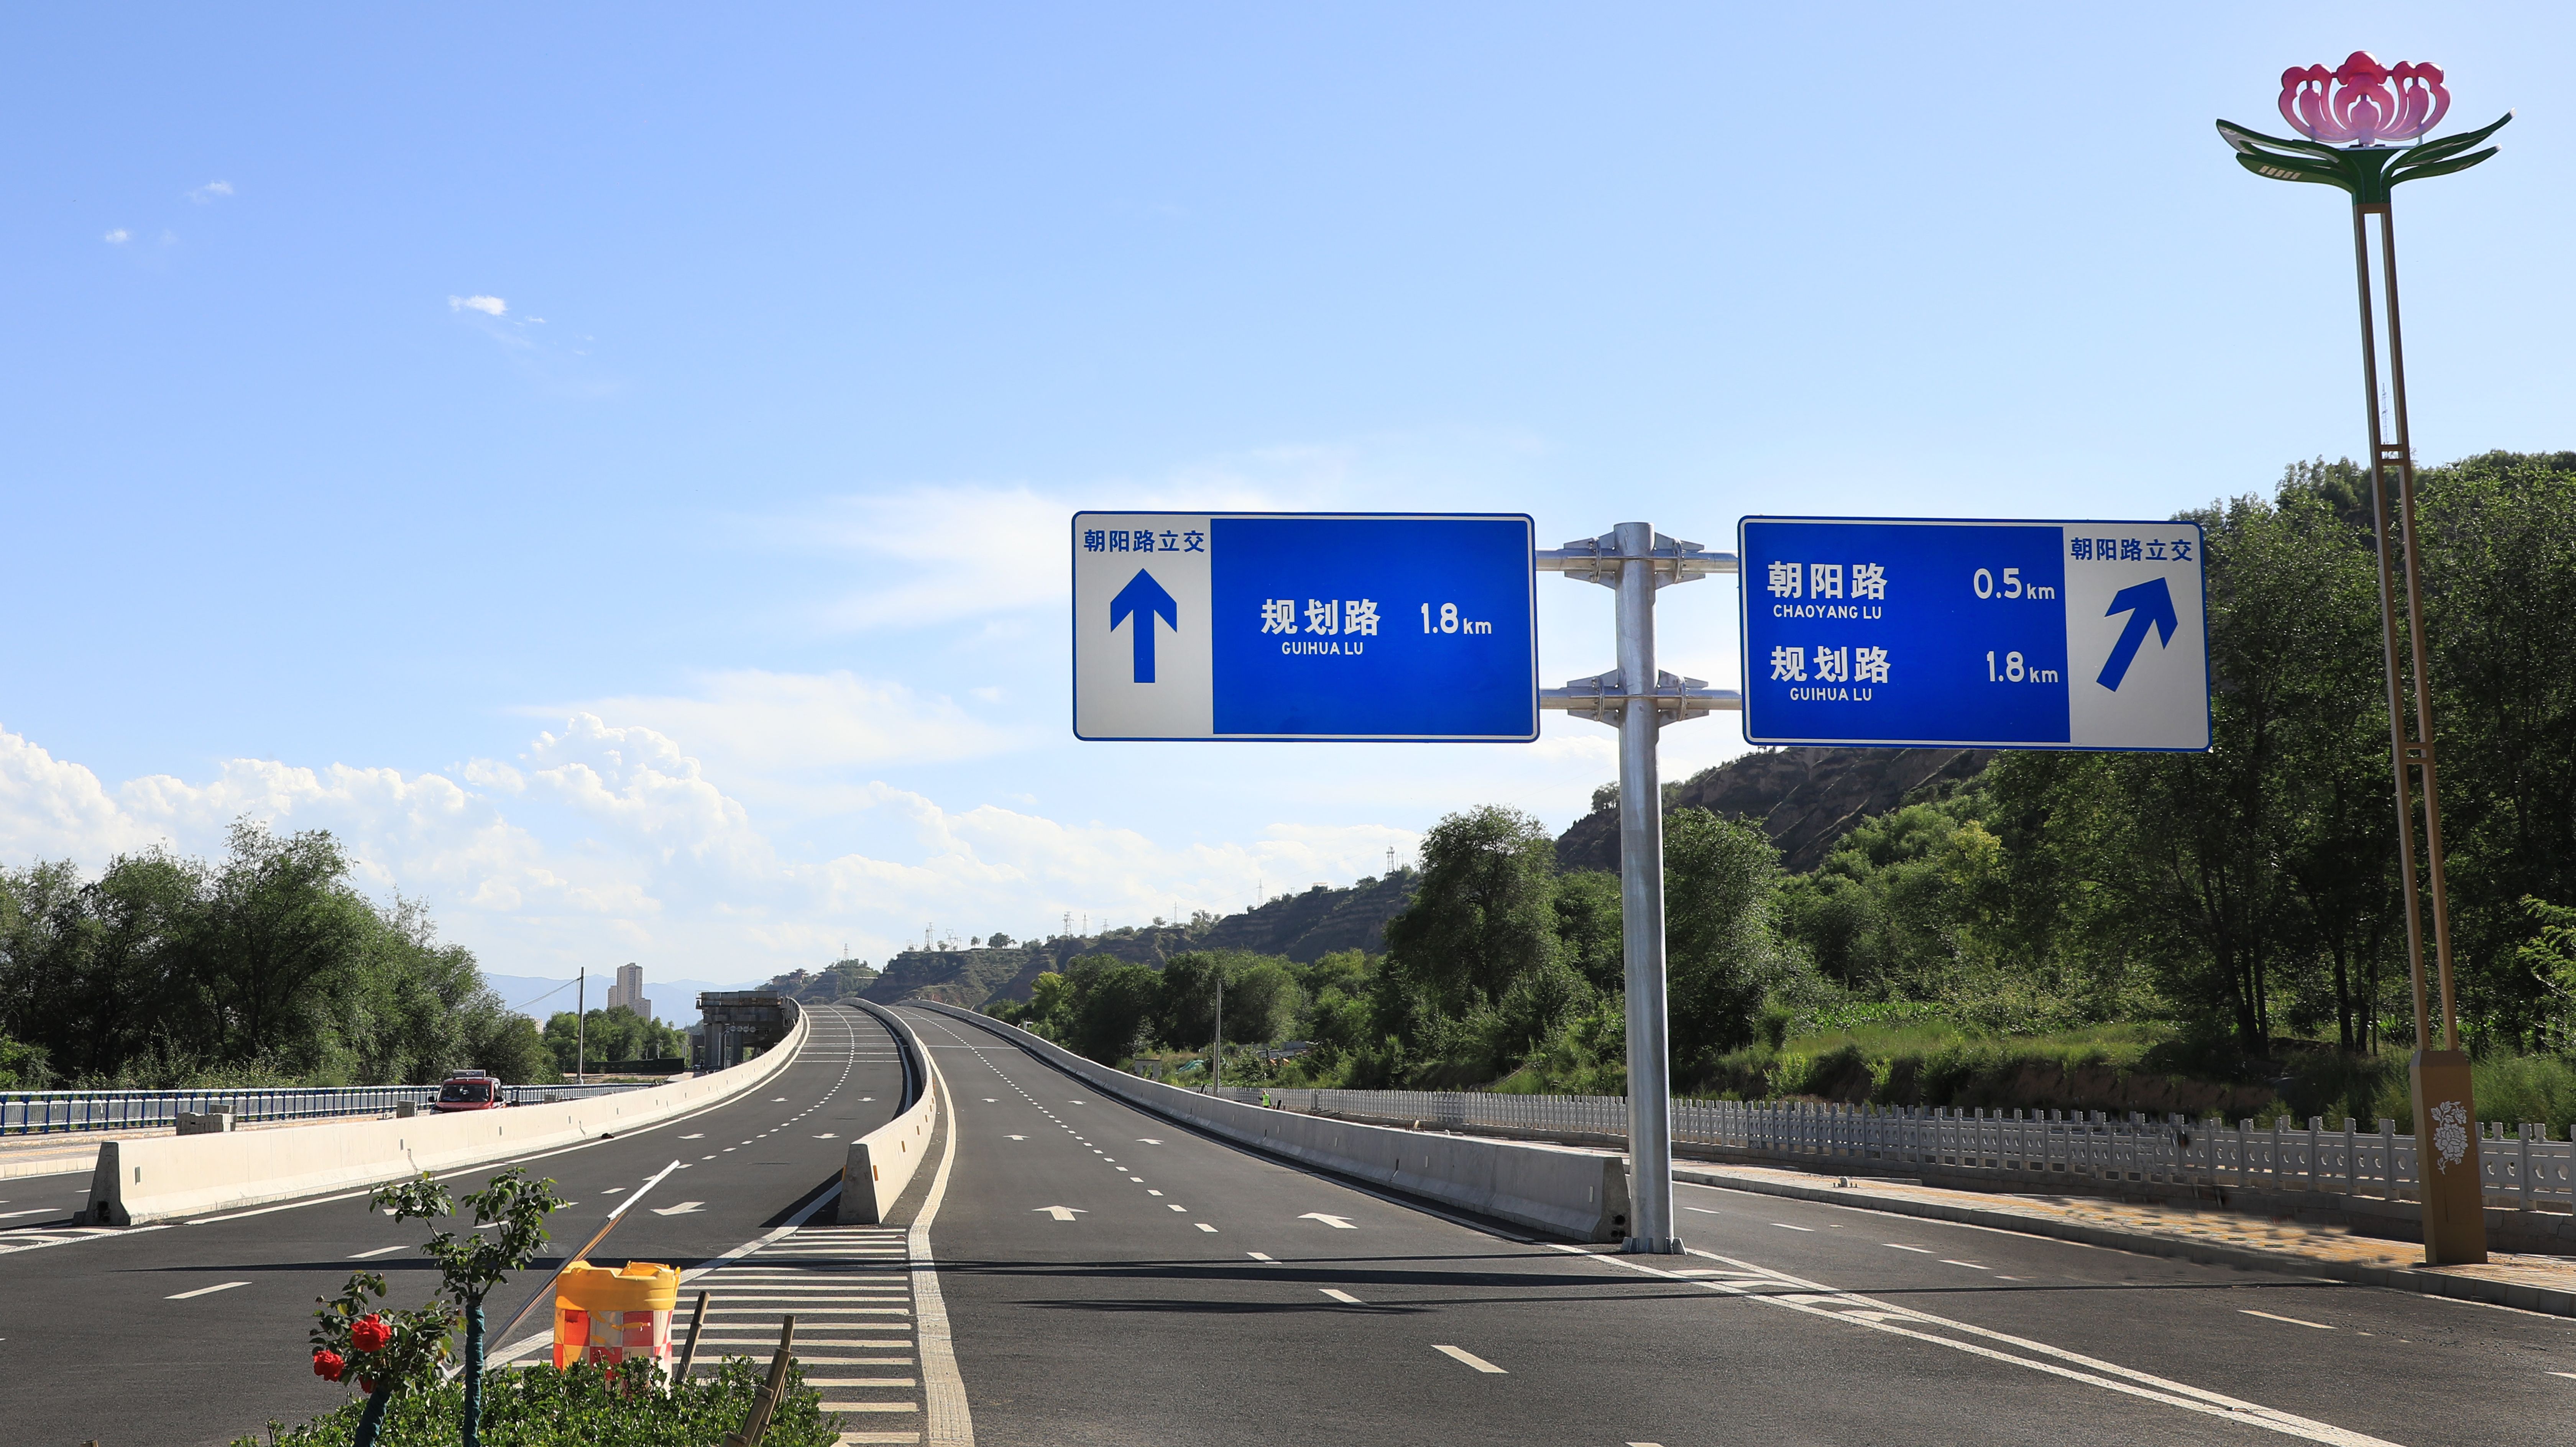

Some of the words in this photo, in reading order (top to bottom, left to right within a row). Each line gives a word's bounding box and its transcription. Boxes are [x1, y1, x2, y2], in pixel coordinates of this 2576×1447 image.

[1084, 529, 1204, 553] 朝阳路立交
[2071, 537, 2193, 562] 朝阳路立交
[1768, 561, 1888, 600] 朝阳路
[1261, 599, 1381, 635] 规划路
[1773, 604, 1858, 619] CHAOYANG
[1863, 606, 1881, 619] LU
[1282, 641, 1340, 655] GUIHUA
[1345, 642, 1363, 655] LU
[1770, 646, 1891, 683] 规划路
[1790, 687, 1849, 701] GUIHUA
[1853, 688, 1871, 701] LU
